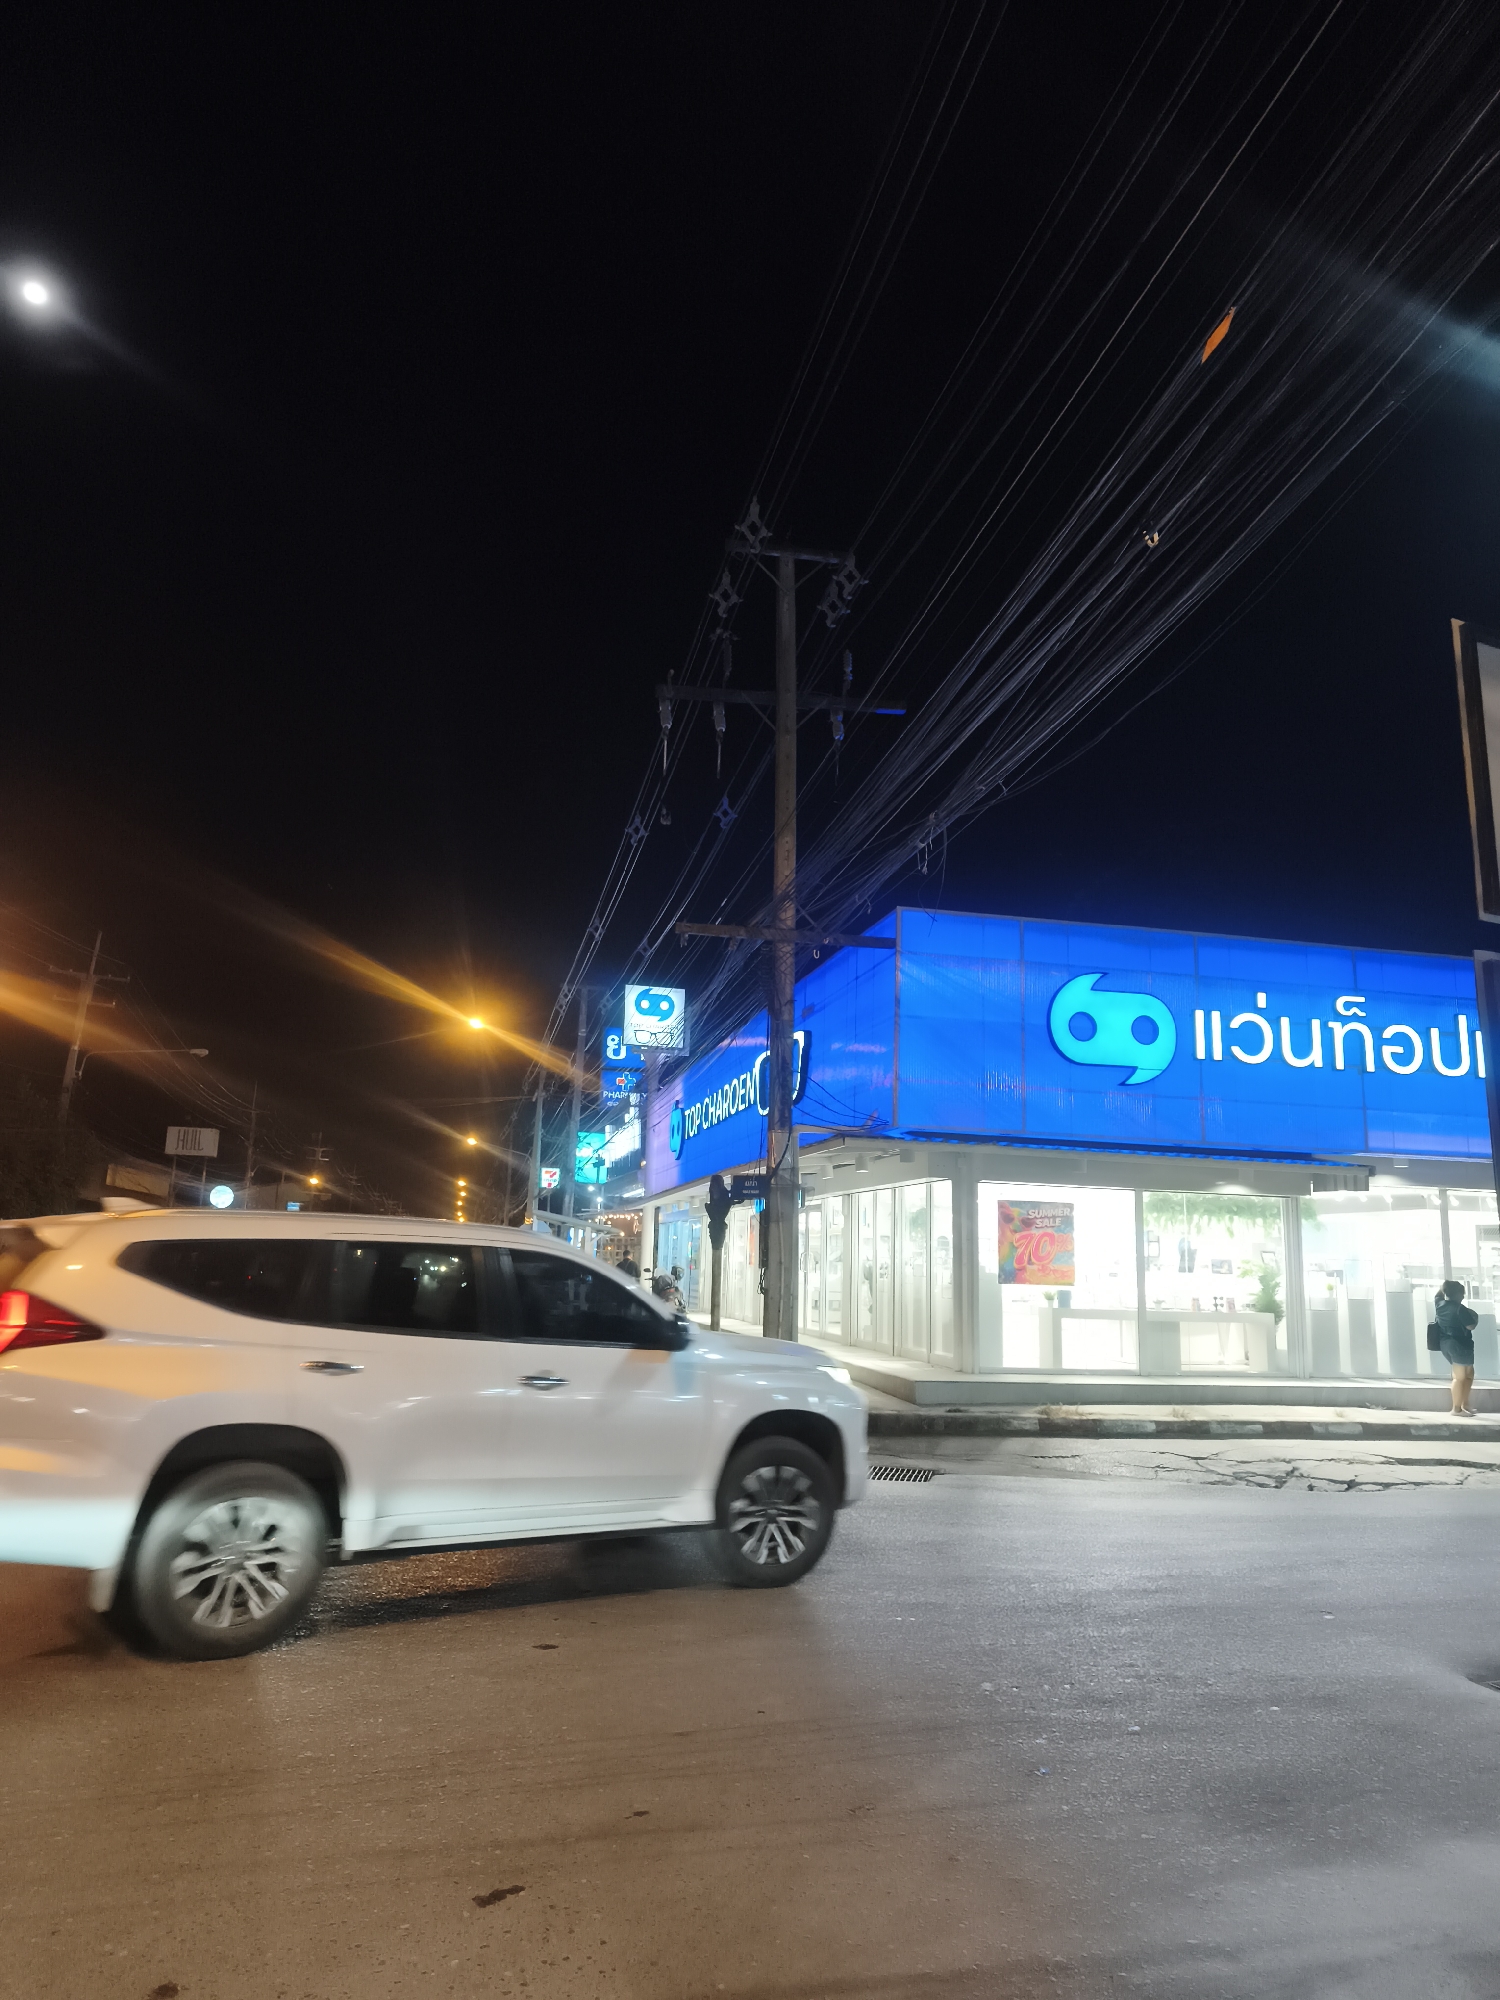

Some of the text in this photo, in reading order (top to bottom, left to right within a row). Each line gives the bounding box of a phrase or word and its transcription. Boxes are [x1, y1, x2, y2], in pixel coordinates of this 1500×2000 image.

[684, 1102, 701, 1140] TOP
[702, 1066, 758, 1130] CHAROEN
[1028, 1207, 1071, 1219] SUMMER
[1035, 1218, 1062, 1229] SALE
[1013, 1230, 1074, 1269] 70%
